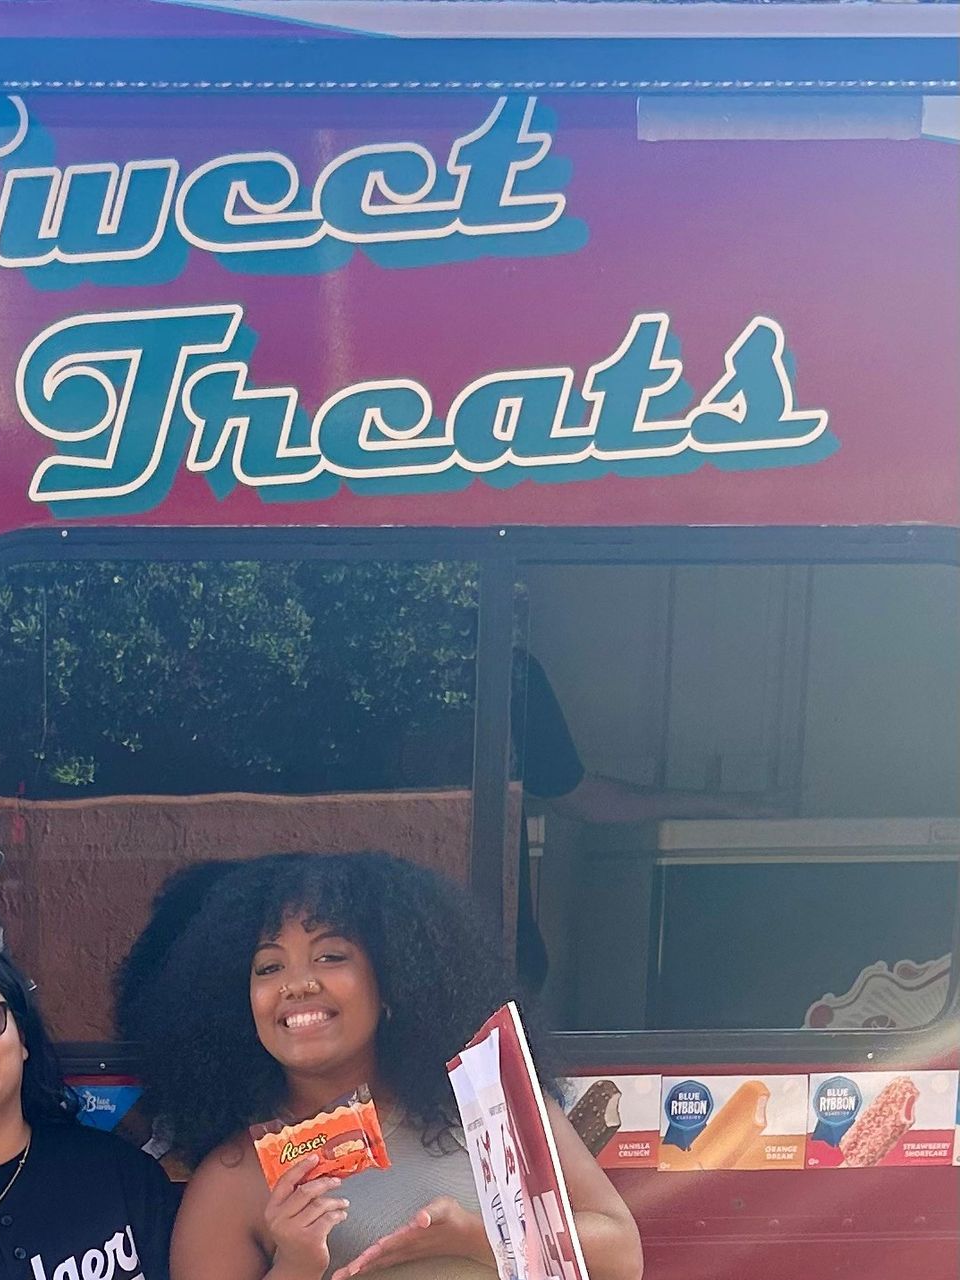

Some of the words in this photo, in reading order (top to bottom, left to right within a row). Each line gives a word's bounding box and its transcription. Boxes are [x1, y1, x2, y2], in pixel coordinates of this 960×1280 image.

[16, 304, 828, 503] Treats
[678, 1092, 700, 1101] BLUE
[827, 1088, 849, 1097] BLUE
[671, 1100, 708, 1116] RIBBON
[820, 1096, 856, 1112] RIBBON
[280, 1133, 328, 1164] Reese's
[618, 1142, 651, 1150] VANILLA
[765, 1145, 797, 1153] ORANGE
[903, 1142, 951, 1150] STRAWBERRY
[618, 1150, 650, 1158] CRUNCH
[904, 1150, 948, 1158] SHORTCAKE
